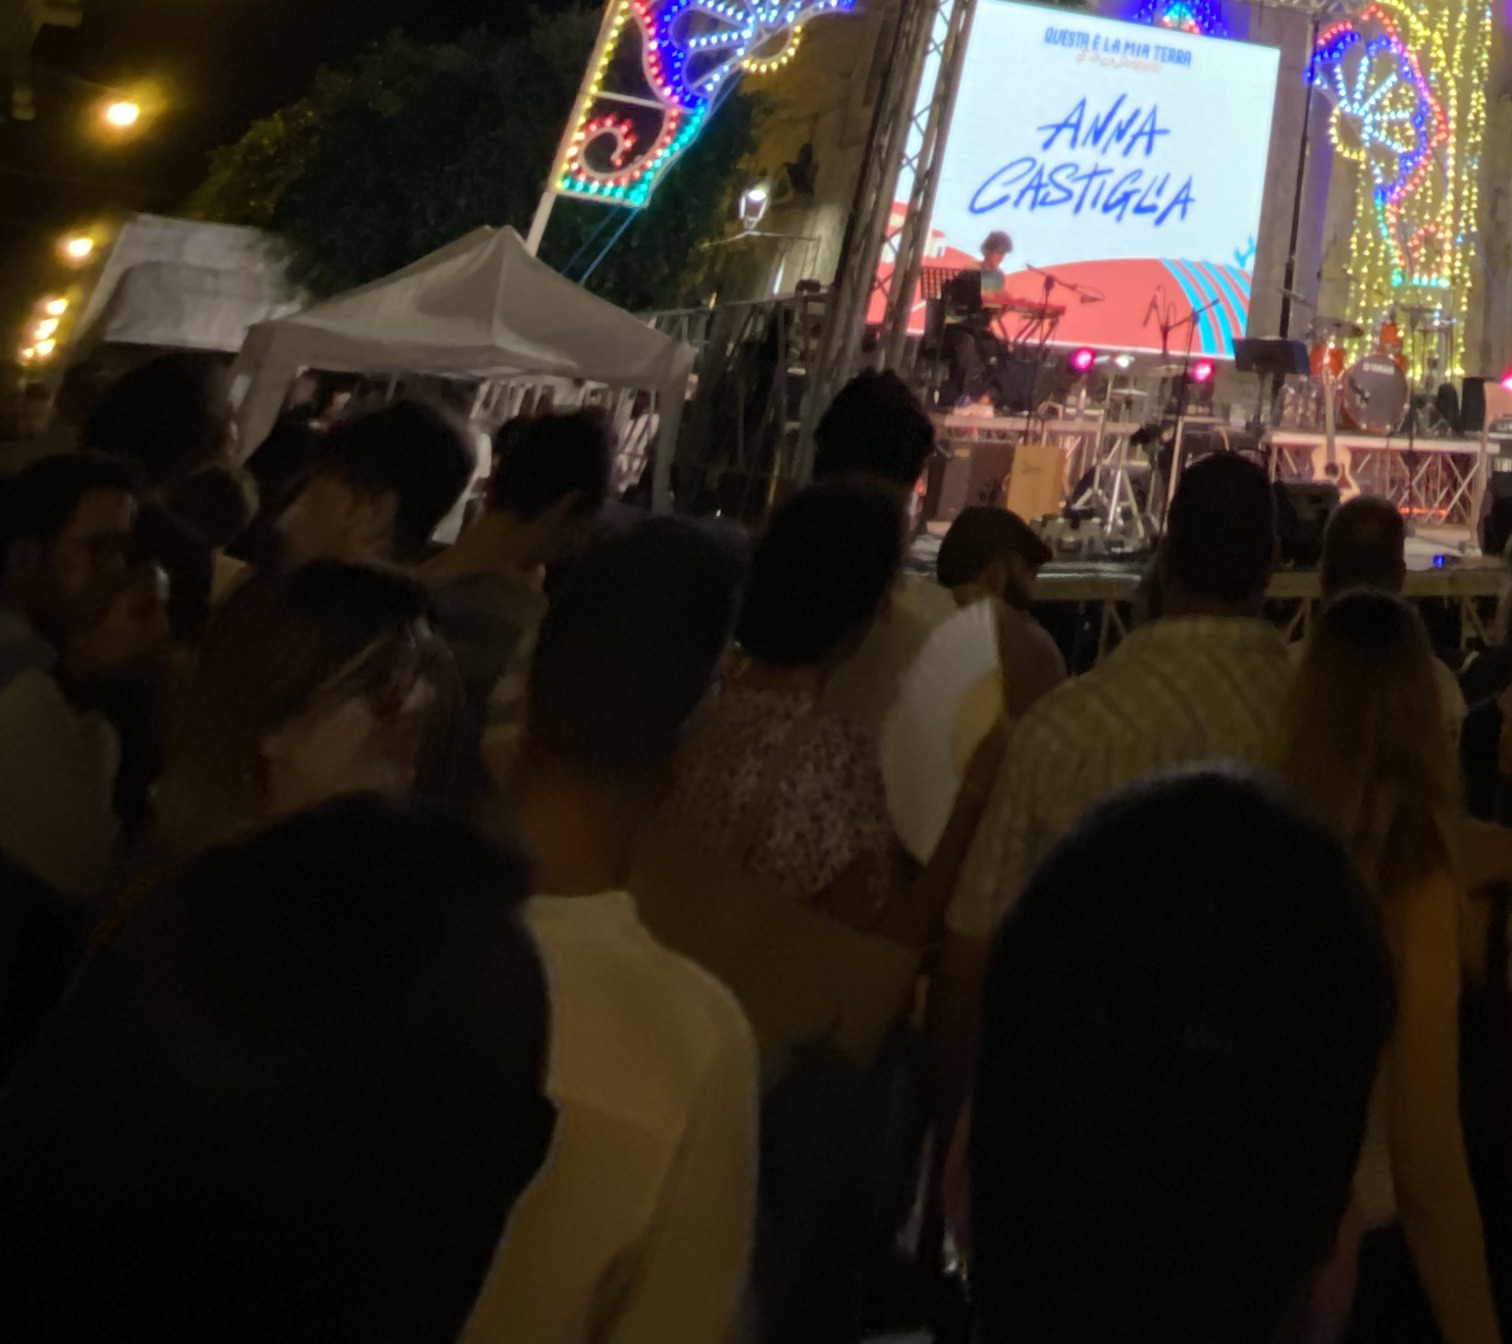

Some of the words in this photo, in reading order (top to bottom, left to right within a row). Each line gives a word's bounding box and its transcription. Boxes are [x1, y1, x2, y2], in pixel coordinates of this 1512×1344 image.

[1044, 27, 1090, 48] QUESTA
[1103, 37, 1121, 53] LA
[1123, 41, 1150, 58] MIA
[1154, 45, 1192, 67] TERRA
[1038, 93, 1171, 158] ANNA
[967, 156, 1196, 228] CASTIGLIA
